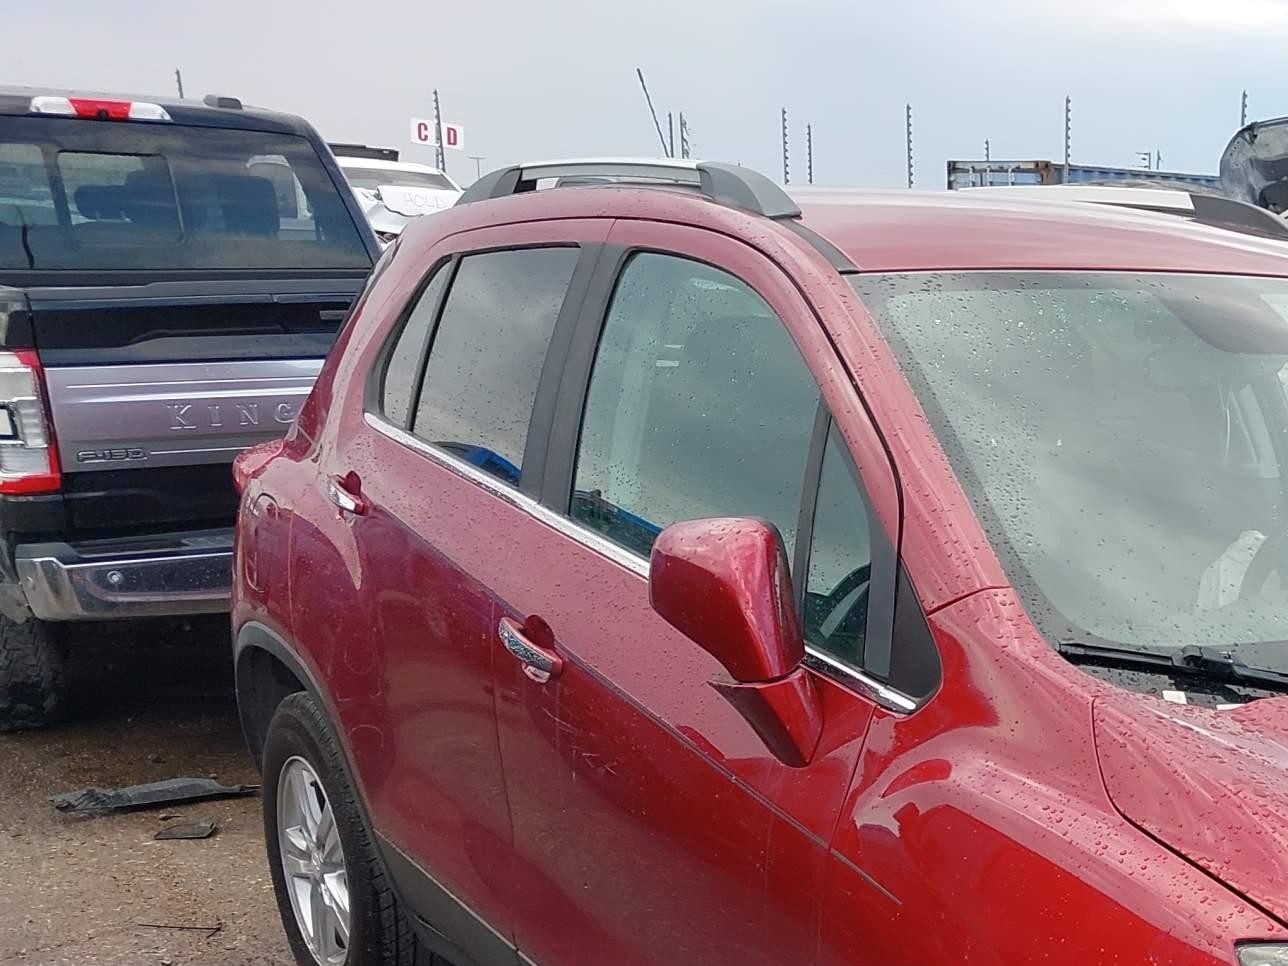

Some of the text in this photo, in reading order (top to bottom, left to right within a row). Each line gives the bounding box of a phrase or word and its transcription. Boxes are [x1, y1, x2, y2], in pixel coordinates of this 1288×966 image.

[417, 122, 429, 142] C
[446, 126, 458, 146] D
[167, 403, 296, 430] KING
